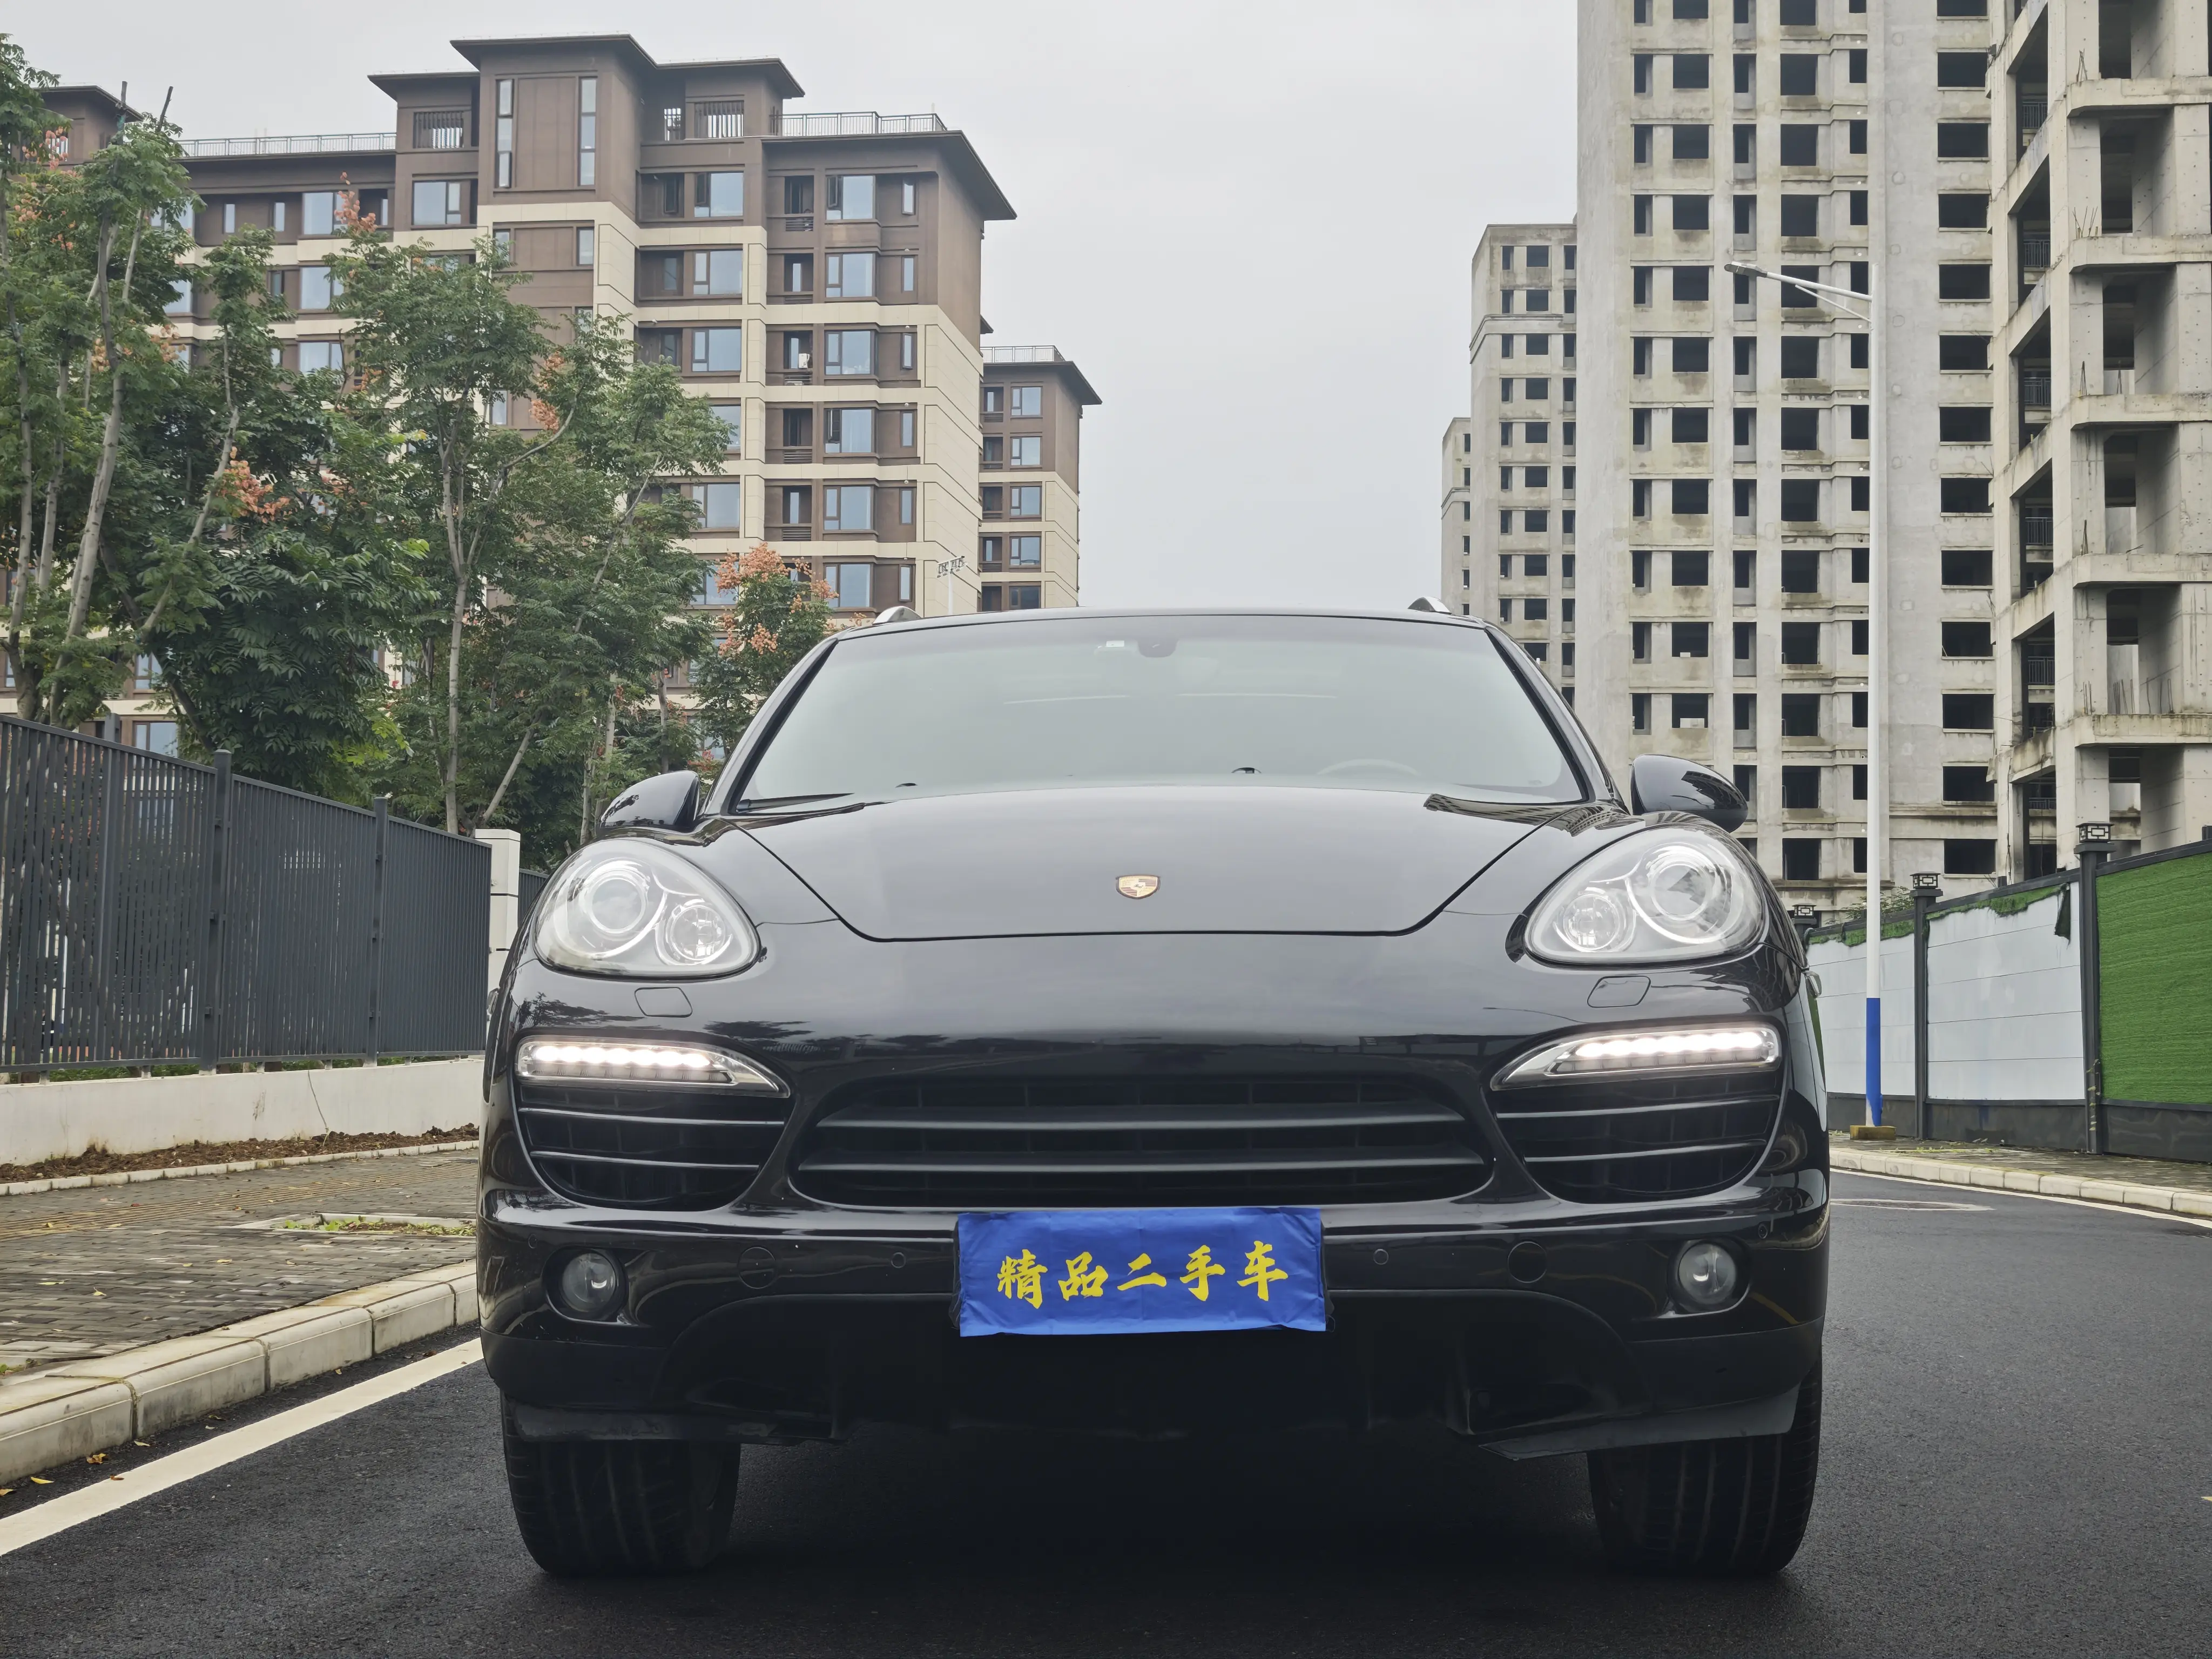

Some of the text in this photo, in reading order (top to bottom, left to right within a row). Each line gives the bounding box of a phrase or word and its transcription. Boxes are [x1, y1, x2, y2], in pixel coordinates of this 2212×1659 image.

[997, 1240, 1288, 1309] 精品二手车
